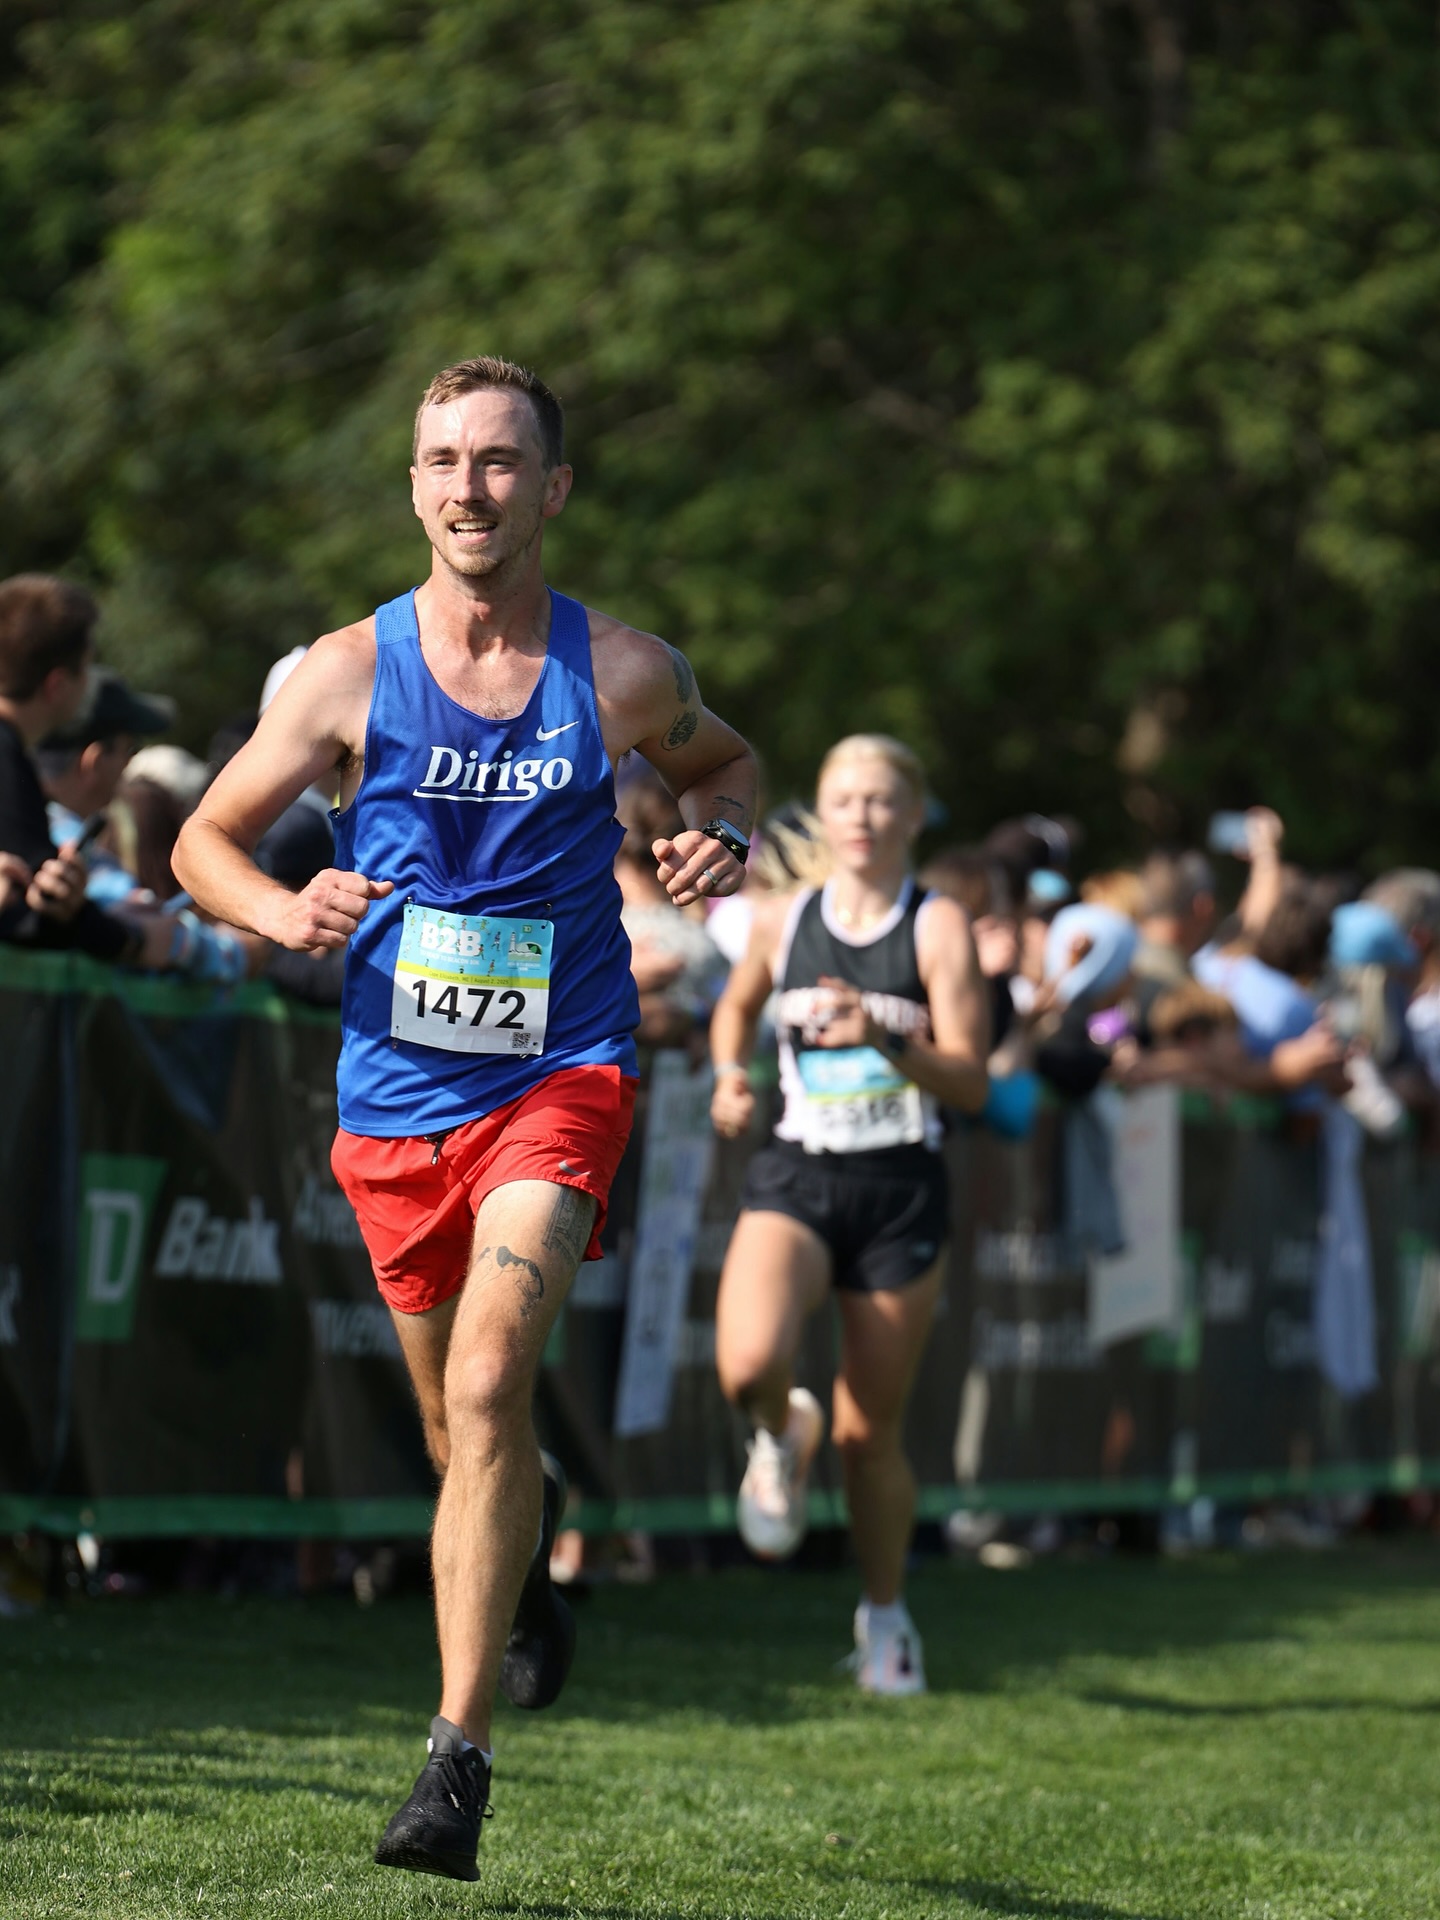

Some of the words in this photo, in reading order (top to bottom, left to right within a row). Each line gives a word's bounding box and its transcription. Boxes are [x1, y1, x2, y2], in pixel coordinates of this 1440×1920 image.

[413, 746, 573, 802] Dirigo
[421, 922, 481, 956] B2B
[412, 979, 526, 1030] 1472
[155, 1195, 283, 1286] Bank
